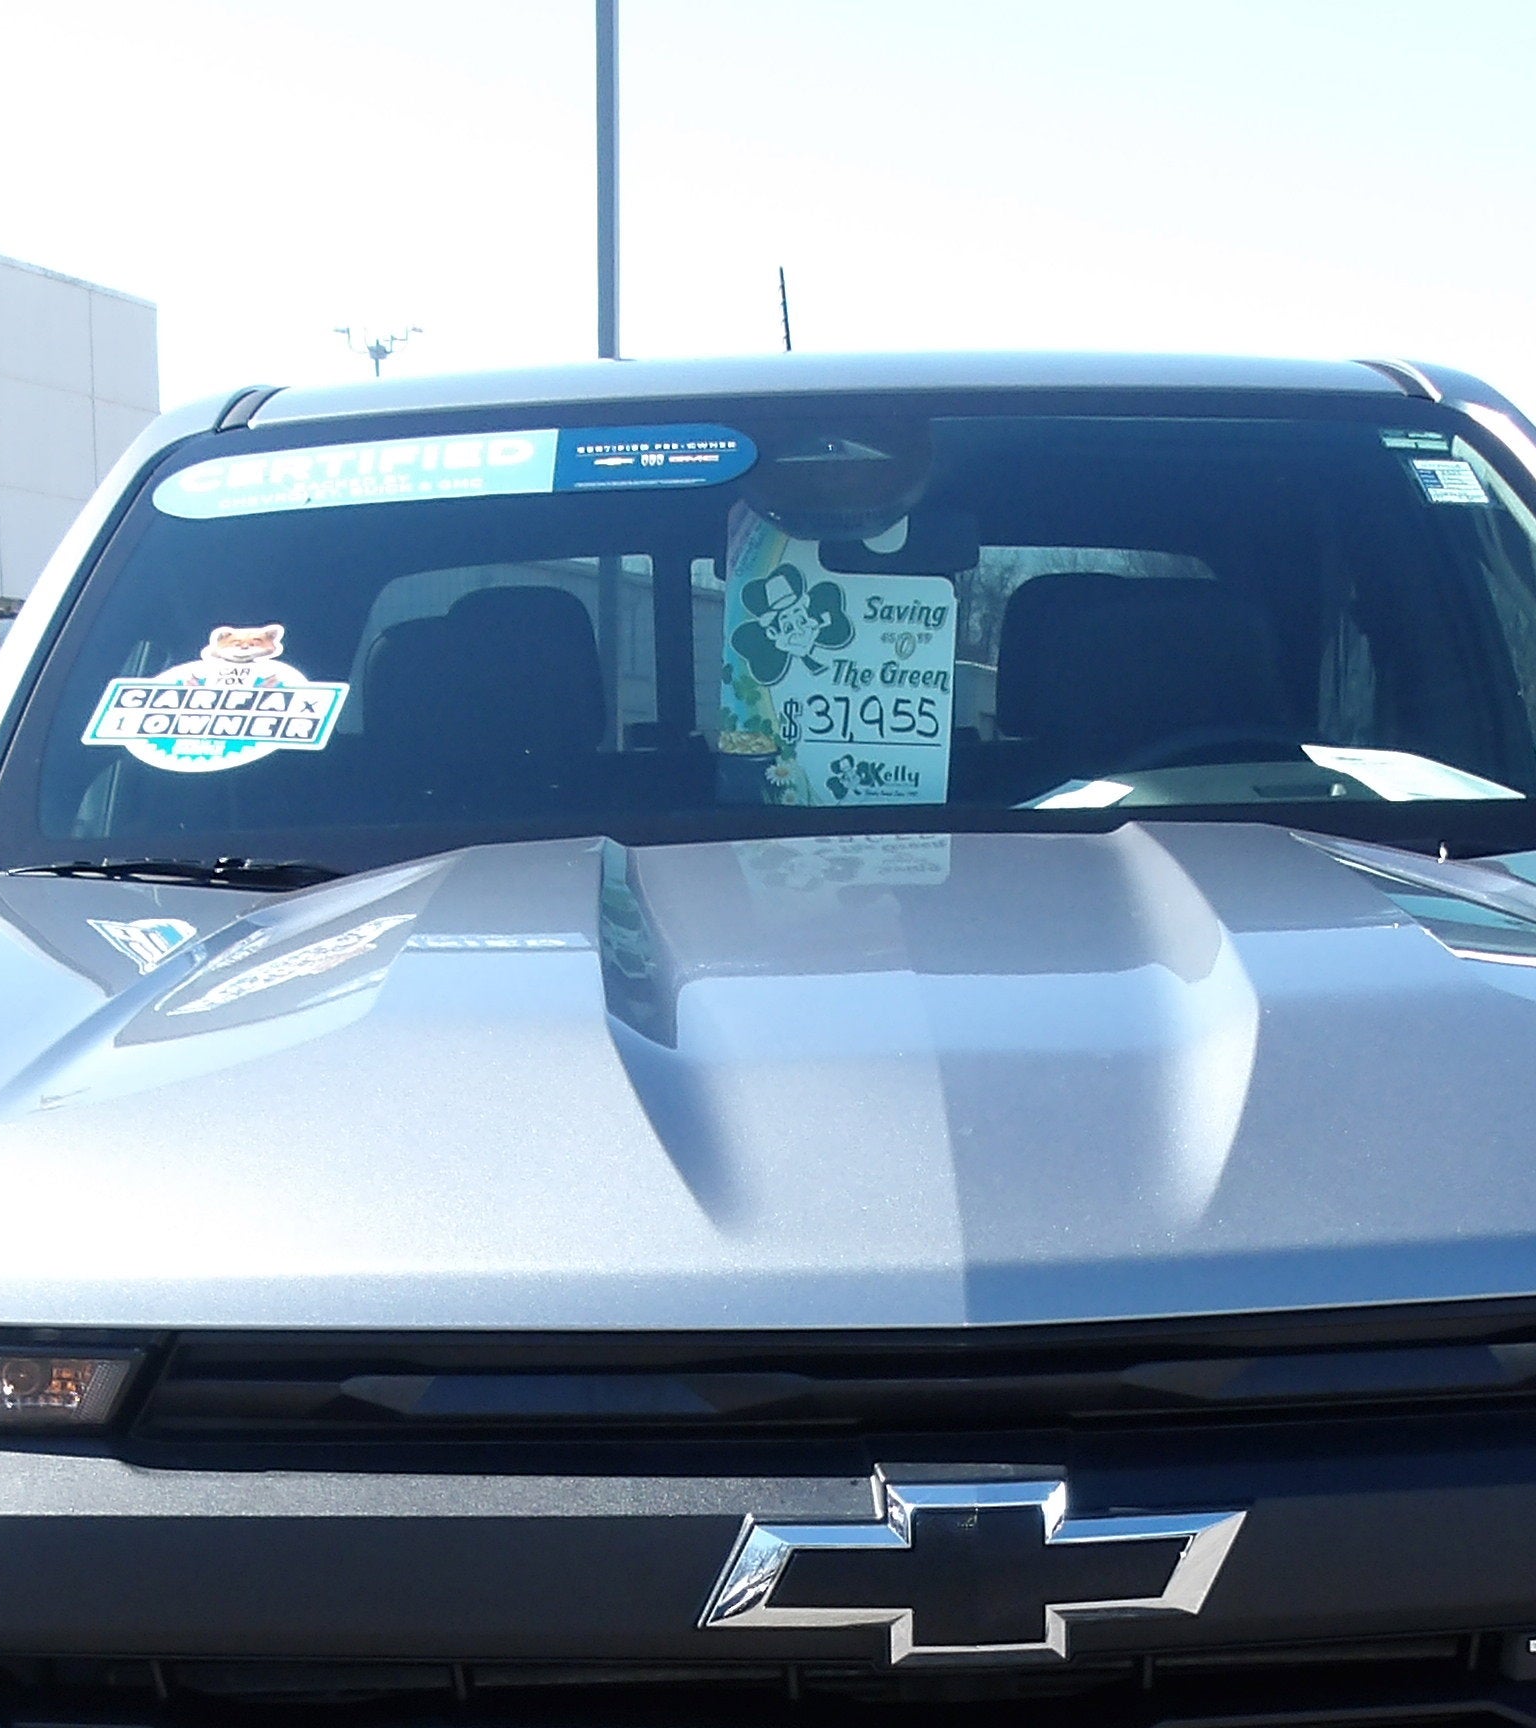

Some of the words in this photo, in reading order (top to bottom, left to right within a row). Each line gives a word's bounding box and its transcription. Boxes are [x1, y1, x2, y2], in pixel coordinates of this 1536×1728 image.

[178, 438, 535, 493] CERTIFIED
[864, 596, 948, 630] Saving
[832, 659, 874, 692] The
[879, 660, 951, 694] Green
[140, 714, 315, 738] OWNER
[867, 761, 920, 788] Kelly
